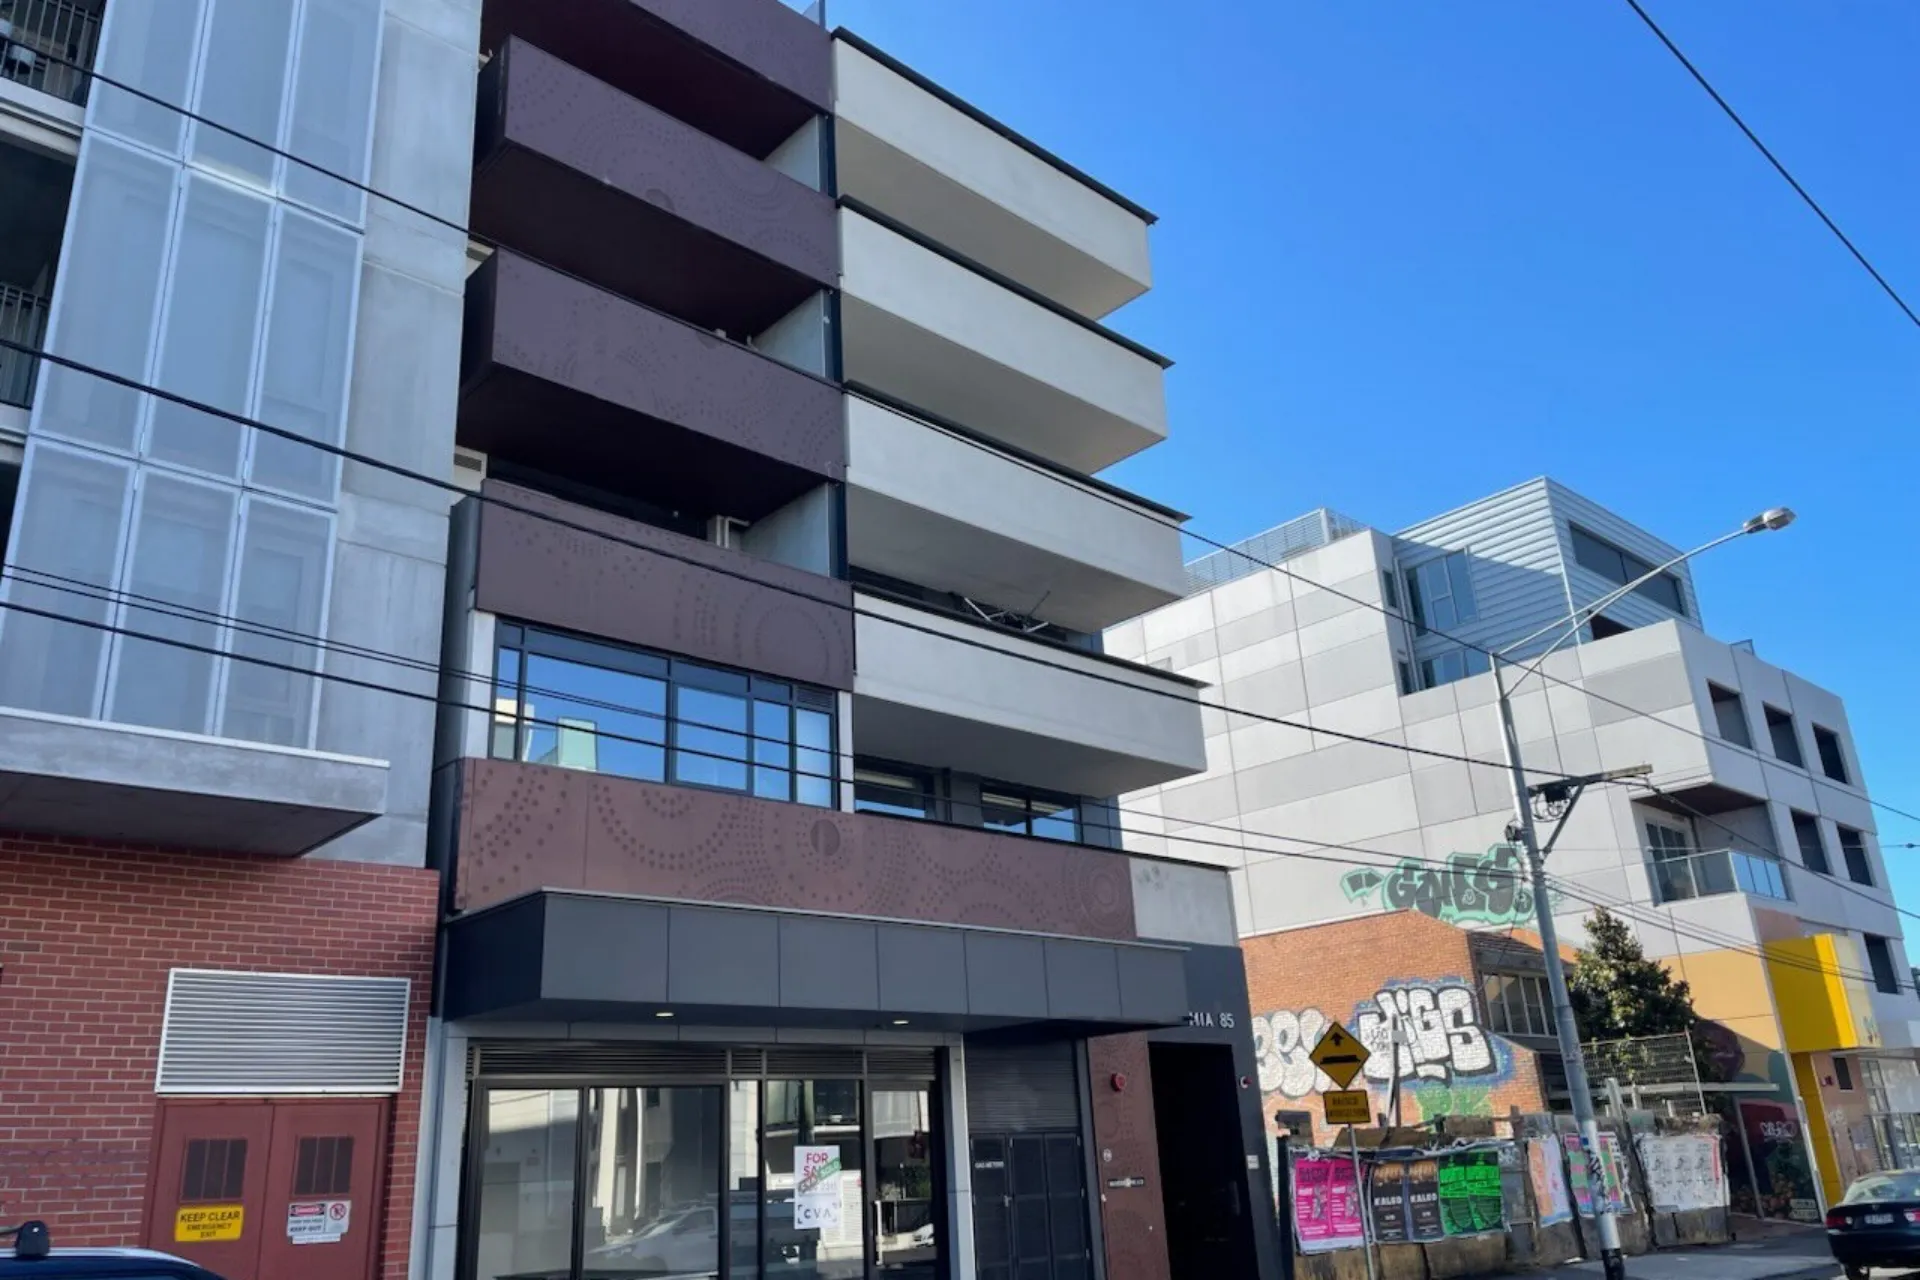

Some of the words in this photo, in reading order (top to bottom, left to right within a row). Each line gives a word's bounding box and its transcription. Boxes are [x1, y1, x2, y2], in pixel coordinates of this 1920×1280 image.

[1219, 1012, 1235, 1029] 85
[806, 1152, 828, 1164] FOR
[180, 1212, 207, 1223] KEEP
[208, 1210, 241, 1221] CLEAR
[804, 1208, 831, 1219] CVA
